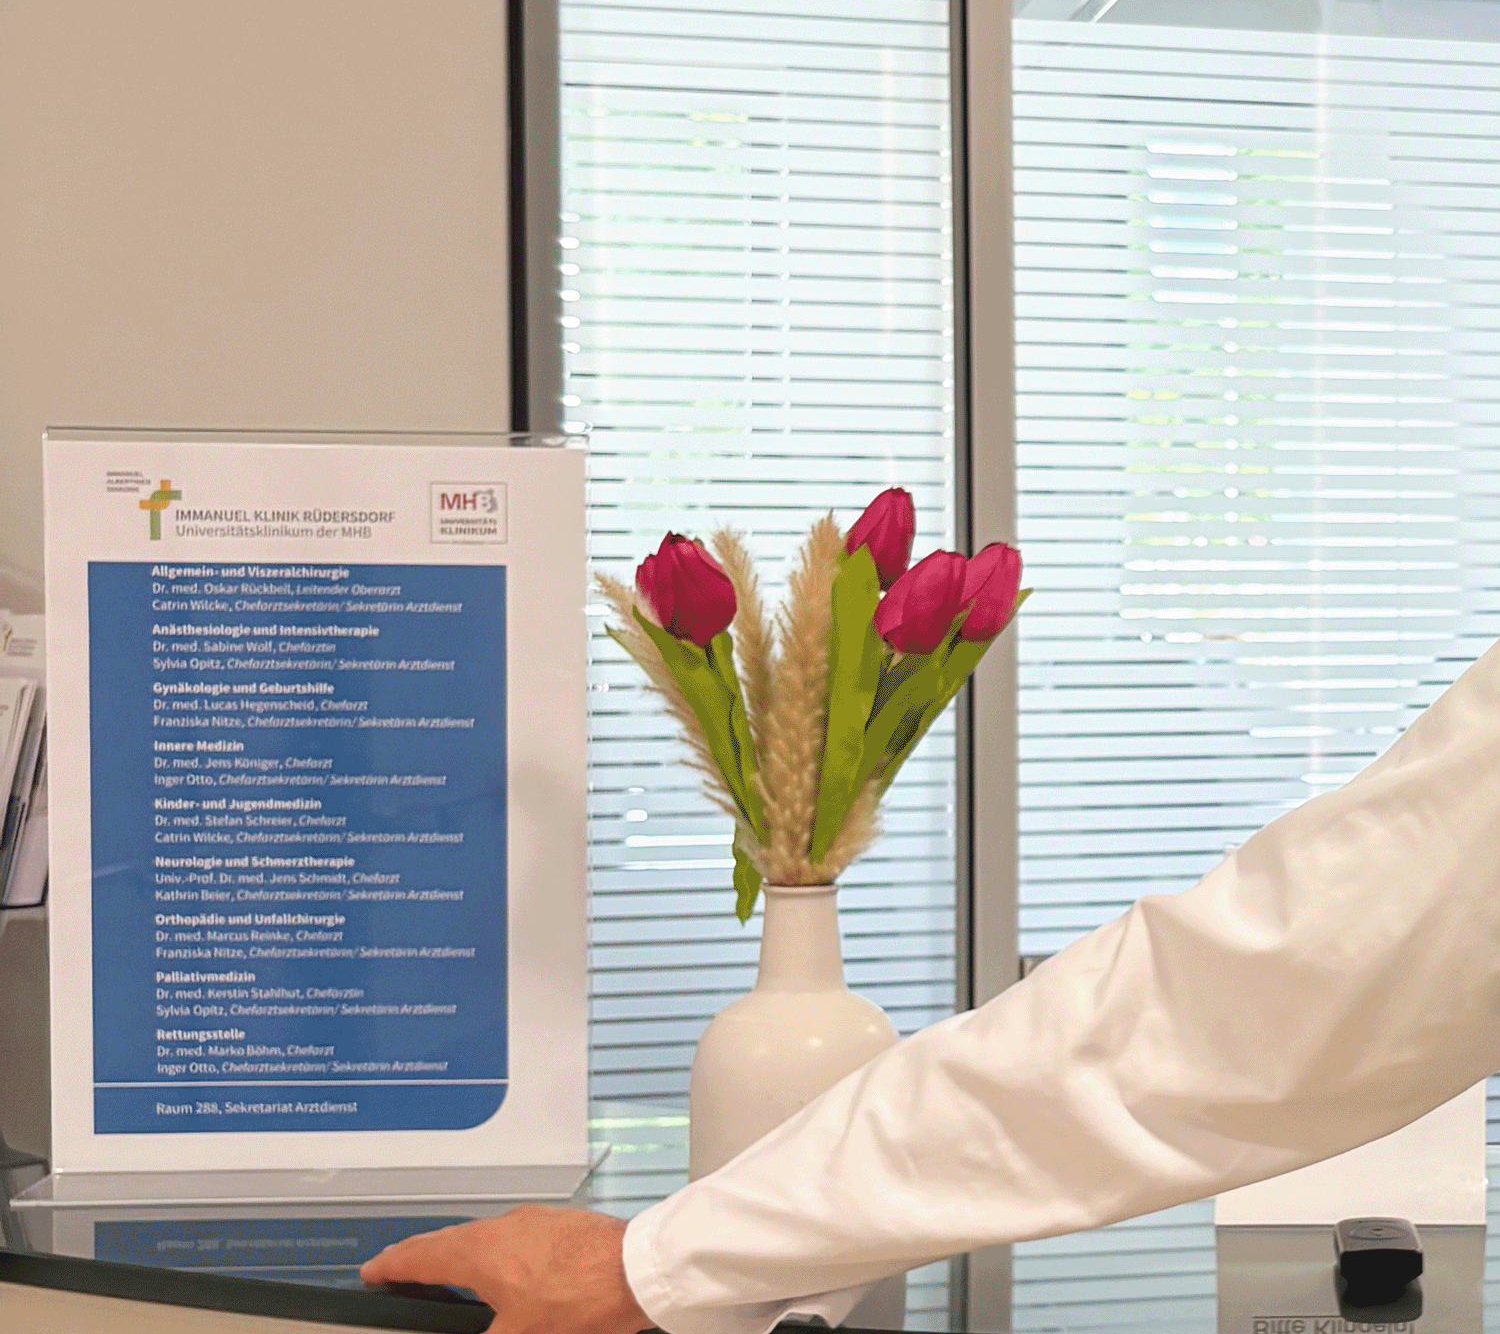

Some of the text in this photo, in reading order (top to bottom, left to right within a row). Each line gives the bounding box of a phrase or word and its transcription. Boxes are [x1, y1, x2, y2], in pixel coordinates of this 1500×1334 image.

[439, 489, 498, 514] MHB
[175, 507, 397, 524] IMMANUEL KLINIK RÜDERSDORF
[175, 524, 372, 539] Universitätsklinikum der MHB
[439, 526, 498, 536] KLINIKUM
[151, 565, 350, 581] Allgemein- und Viszeralchirurgie
[151, 583, 169, 595] Dr.
[171, 583, 202, 595] med.
[203, 583, 239, 595] Oskar
[240, 583, 295, 597] Rückbeil,
[151, 599, 188, 612] Catrin
[189, 599, 232, 614] Wilcke,
[152, 624, 380, 639] Anästhesiologie und Intensivtherapie
[152, 640, 170, 653] Dr.
[171, 640, 202, 653] med.
[203, 640, 244, 653] Sabine
[245, 640, 277, 655] Wolf,
[152, 657, 188, 673] Sylvia
[189, 657, 226, 673] Opitz,
[152, 681, 335, 697] Gynäkologie und Geburtshilfe
[153, 699, 170, 711] Dr.
[172, 699, 202, 711] med.
[204, 699, 239, 711] Lucas
[240, 699, 319, 714] Hegenscheid,
[153, 715, 209, 728] Franziska
[211, 715, 245, 730] Nitze,
[153, 740, 245, 752] Innere Medizin
[153, 798, 322, 813] Kinder- und Jugendmedizin
[154, 856, 356, 871] Neurologie und Schmerztherapie
[154, 913, 346, 928] Orthopädie und Unfallchirurgie
[155, 971, 256, 983] Palliativmedizin
[156, 1029, 246, 1044] Rettungsstelle
[155, 1102, 358, 1117] Raum 288, Sekretariat Arztdienst
